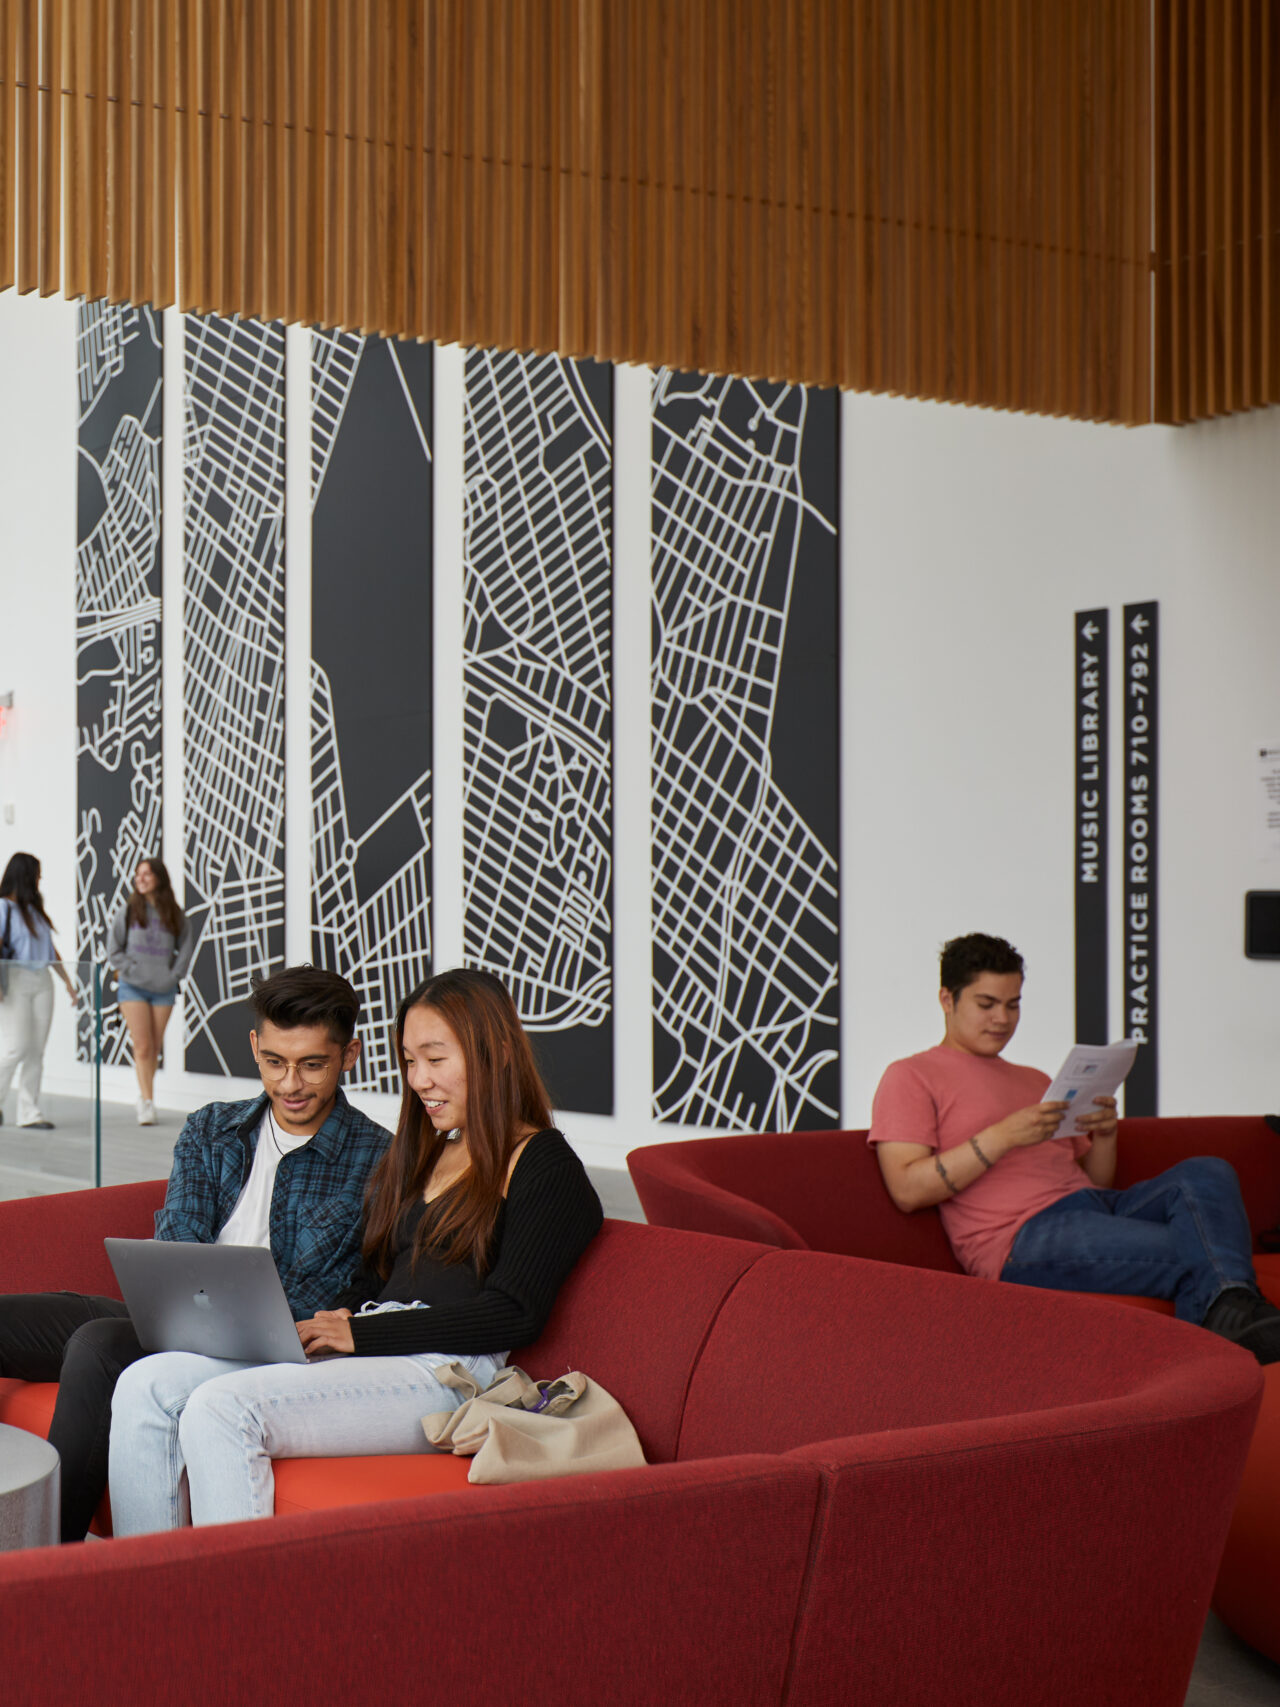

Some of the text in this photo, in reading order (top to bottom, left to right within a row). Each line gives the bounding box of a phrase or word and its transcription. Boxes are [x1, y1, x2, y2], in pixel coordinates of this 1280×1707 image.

[1081, 652, 1099, 883] MUSIC LIBRARY
[1131, 644, 1148, 1045] PRACTICE ROOMS 710-792
